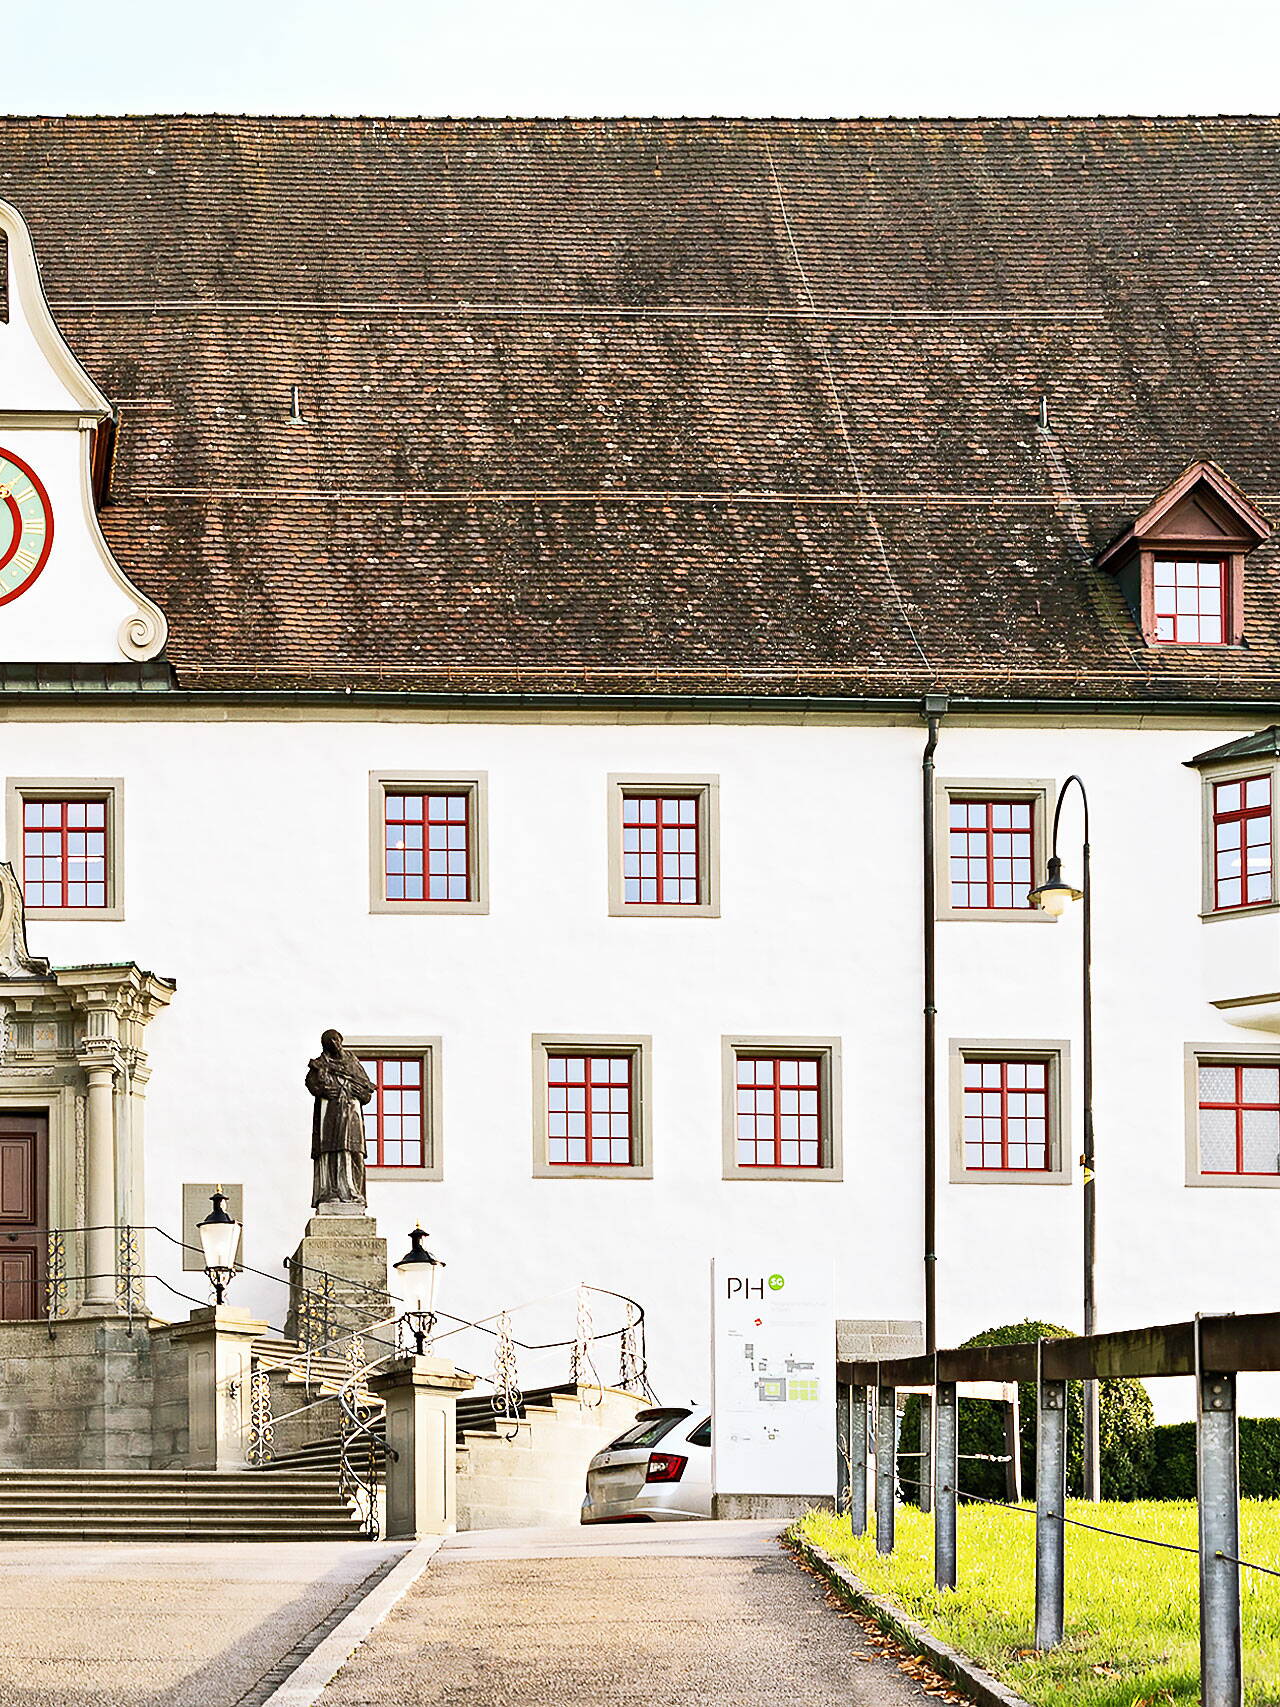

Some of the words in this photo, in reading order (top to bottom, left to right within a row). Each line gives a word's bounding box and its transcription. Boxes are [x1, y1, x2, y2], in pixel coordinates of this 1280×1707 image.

[14, 486, 37, 505] II
[24, 517, 45, 536] III
[11, 547, 37, 574] IIII
[727, 1277, 764, 1299] PH
[770, 1277, 783, 1286] SG
